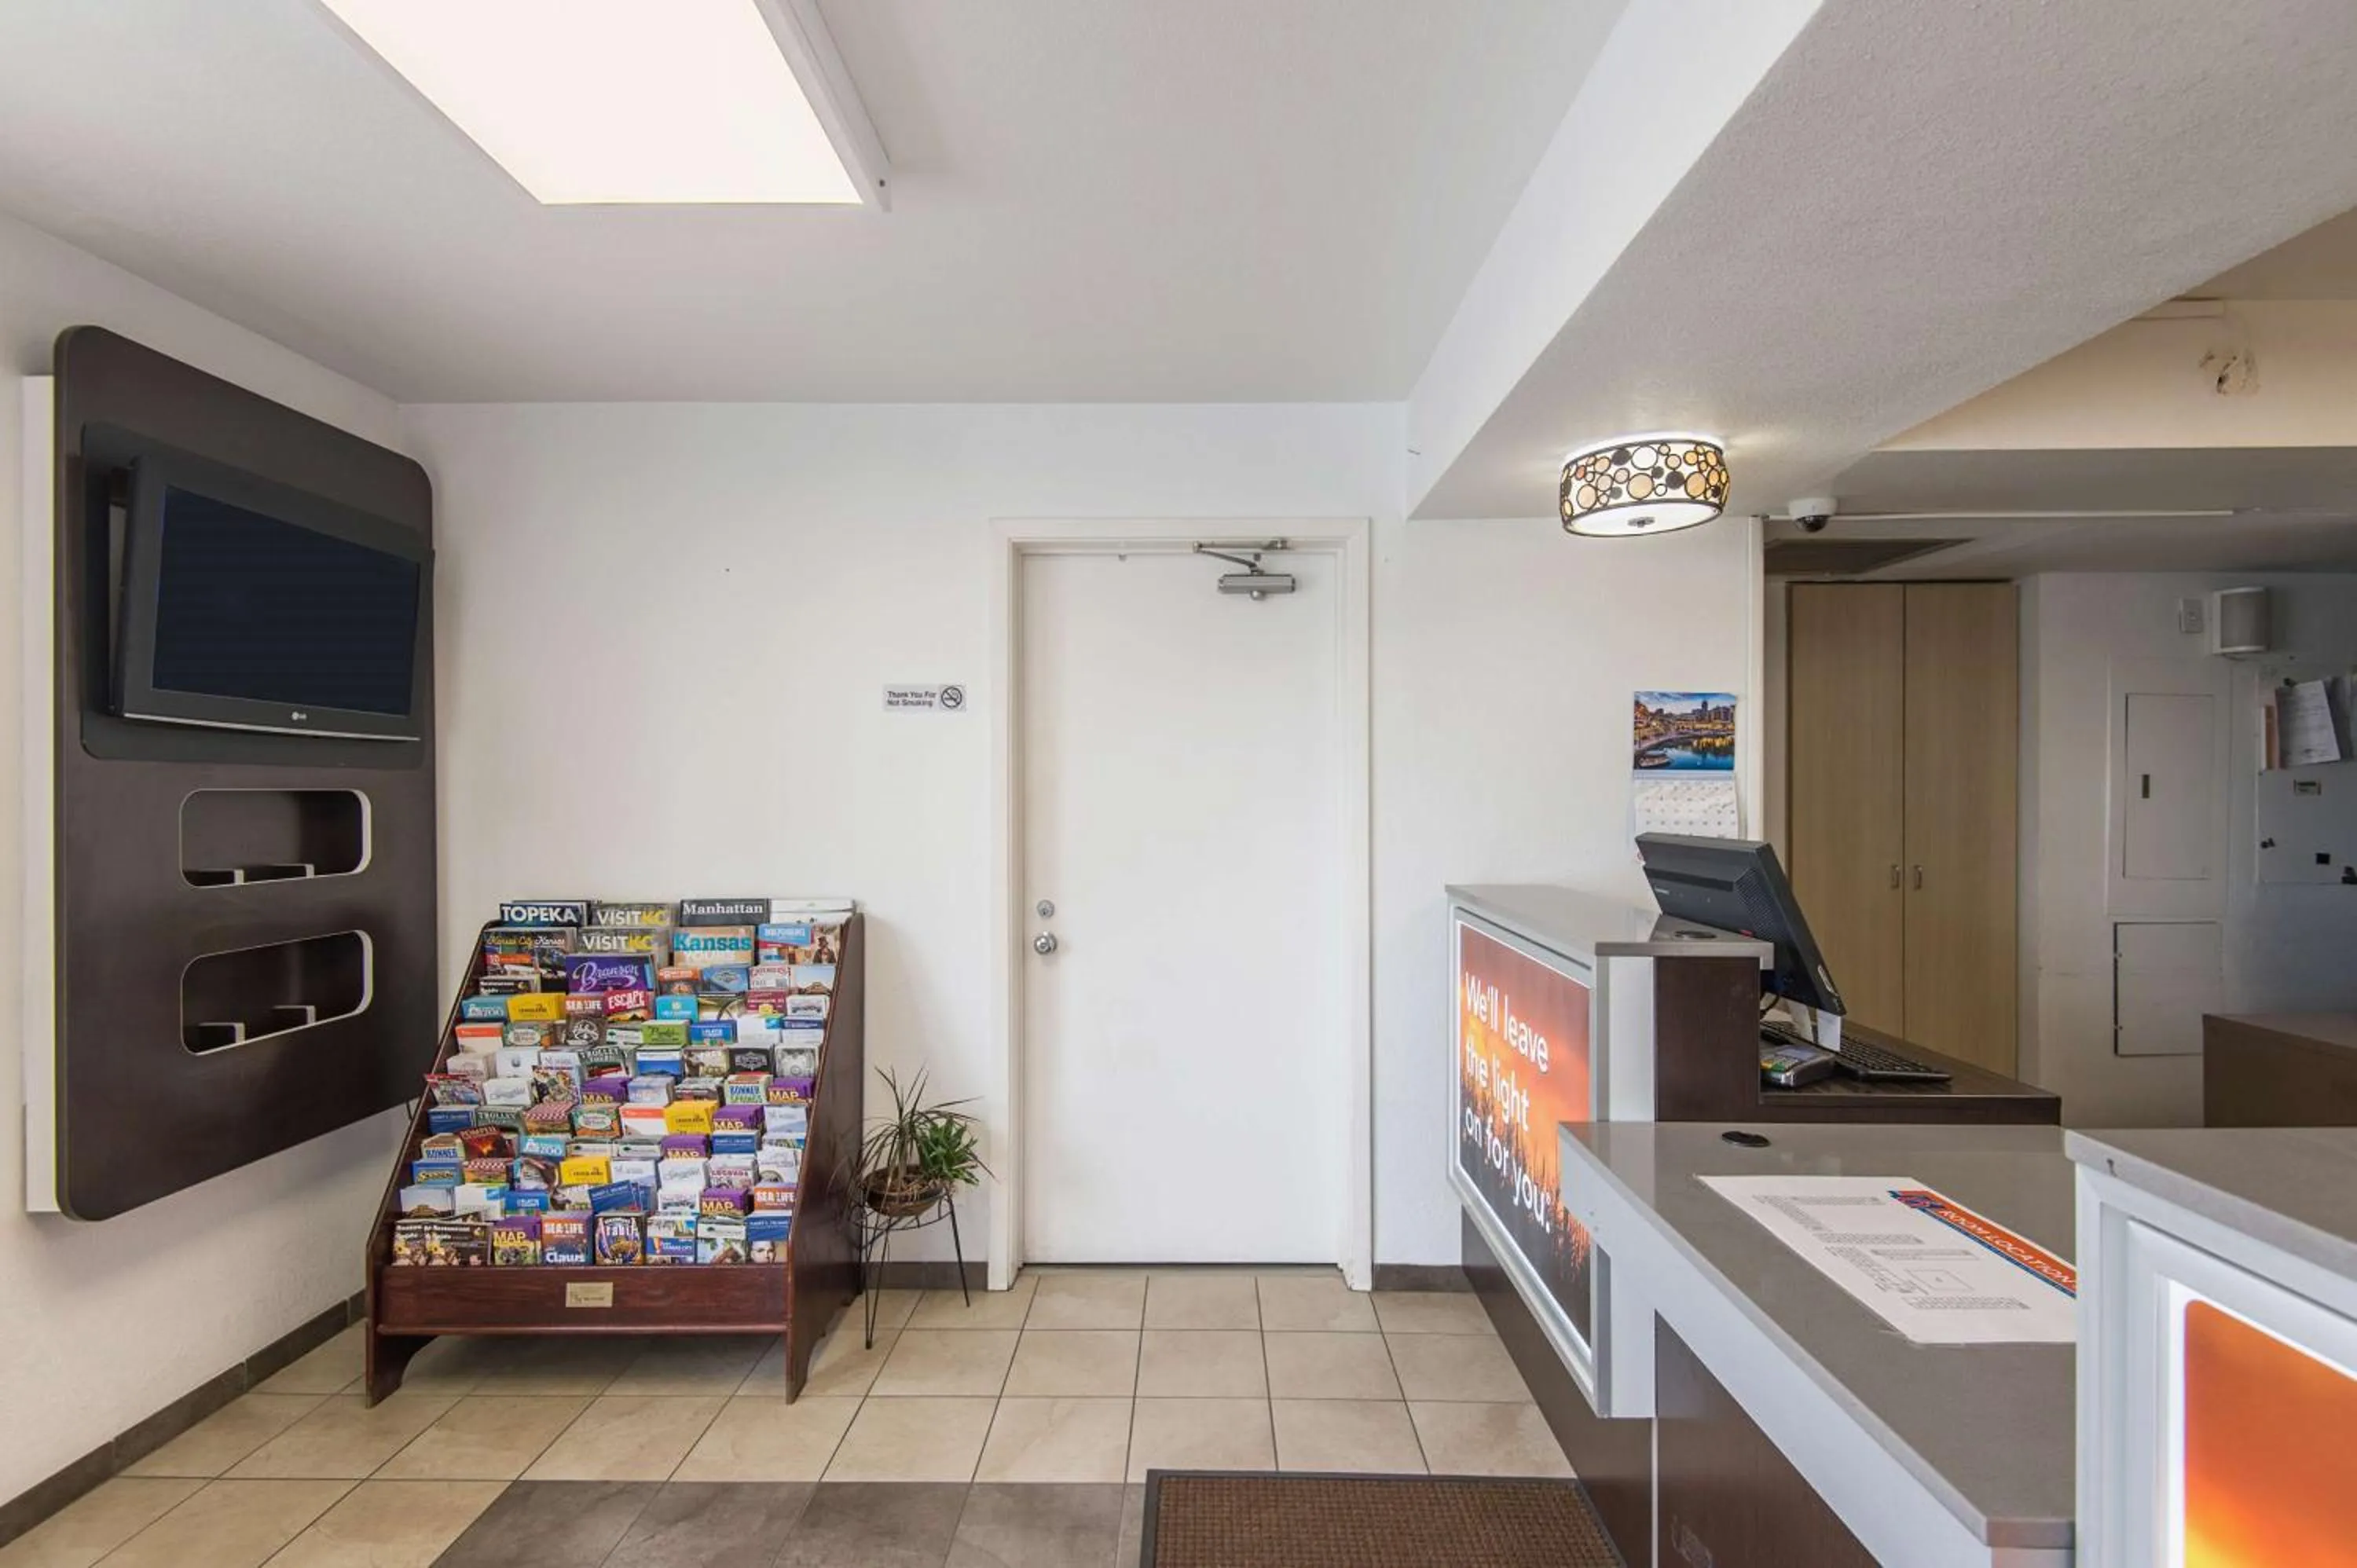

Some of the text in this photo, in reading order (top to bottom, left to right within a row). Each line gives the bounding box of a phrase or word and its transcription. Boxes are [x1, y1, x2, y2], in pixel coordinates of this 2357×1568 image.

[901, 699, 933, 708] Smoking
[501, 906, 577, 922] TOPEKA
[683, 903, 763, 915] Manhattan
[582, 935, 654, 951] VISITKC
[673, 932, 752, 951] Kansas
[572, 962, 640, 991] Branson
[566, 999, 602, 1010] SEA LIFE
[607, 991, 644, 1009] ESCAPE
[1465, 971, 1549, 1073] We'll leave
[1465, 1034, 1530, 1132] the light
[582, 1093, 613, 1105] MAP
[770, 1090, 799, 1101] MAP
[713, 1121, 744, 1130] MAP
[1465, 1106, 1482, 1149] on
[1485, 1114, 1509, 1178] for
[667, 1150, 699, 1159] MAP
[756, 1192, 775, 1202] SEA
[702, 1201, 735, 1212] MAP
[544, 1222, 563, 1234] SEA
[493, 1231, 526, 1243] MAP
[546, 1251, 585, 1263] Claws
